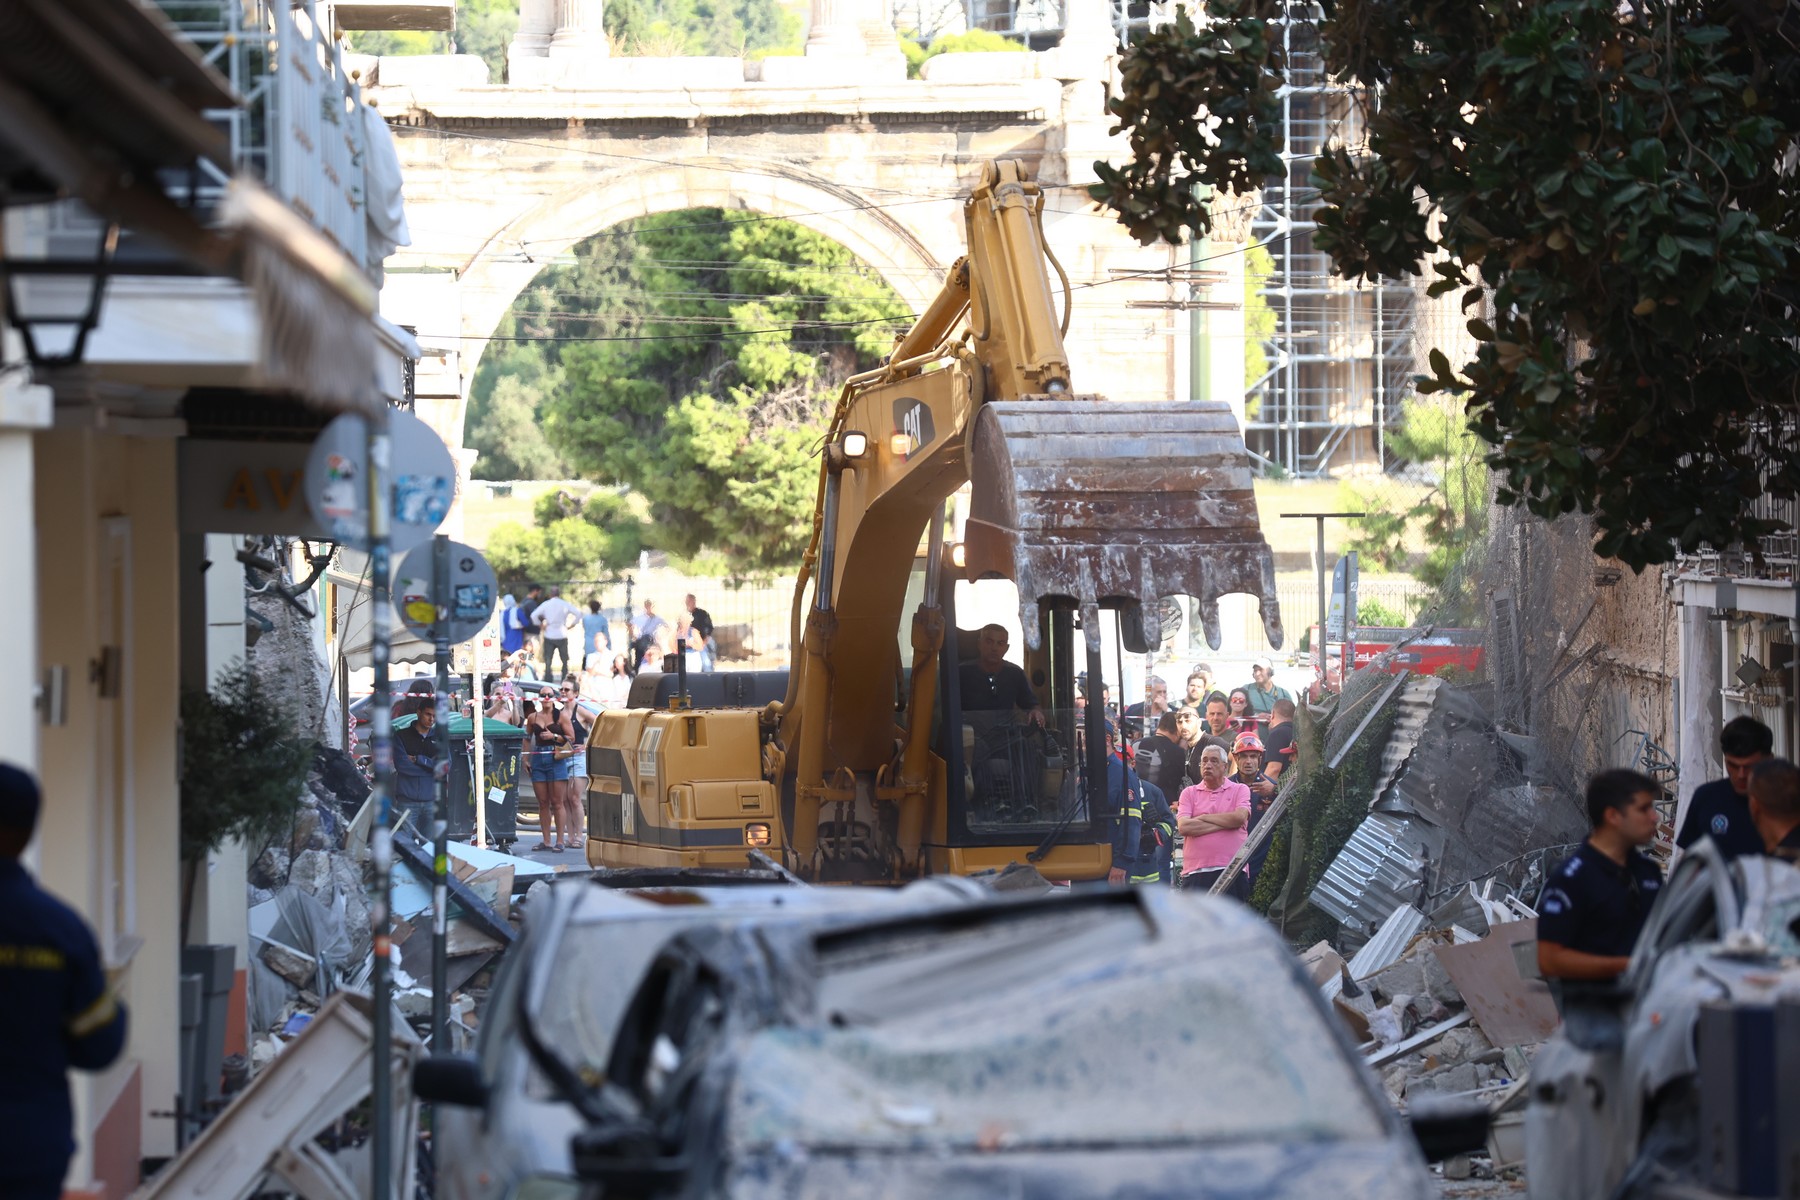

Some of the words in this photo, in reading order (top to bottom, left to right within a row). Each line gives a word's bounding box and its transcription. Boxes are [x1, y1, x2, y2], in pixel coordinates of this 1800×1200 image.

[903, 403, 921, 455] CAT
[223, 466, 310, 513] AV
[621, 793, 635, 835] CAT
